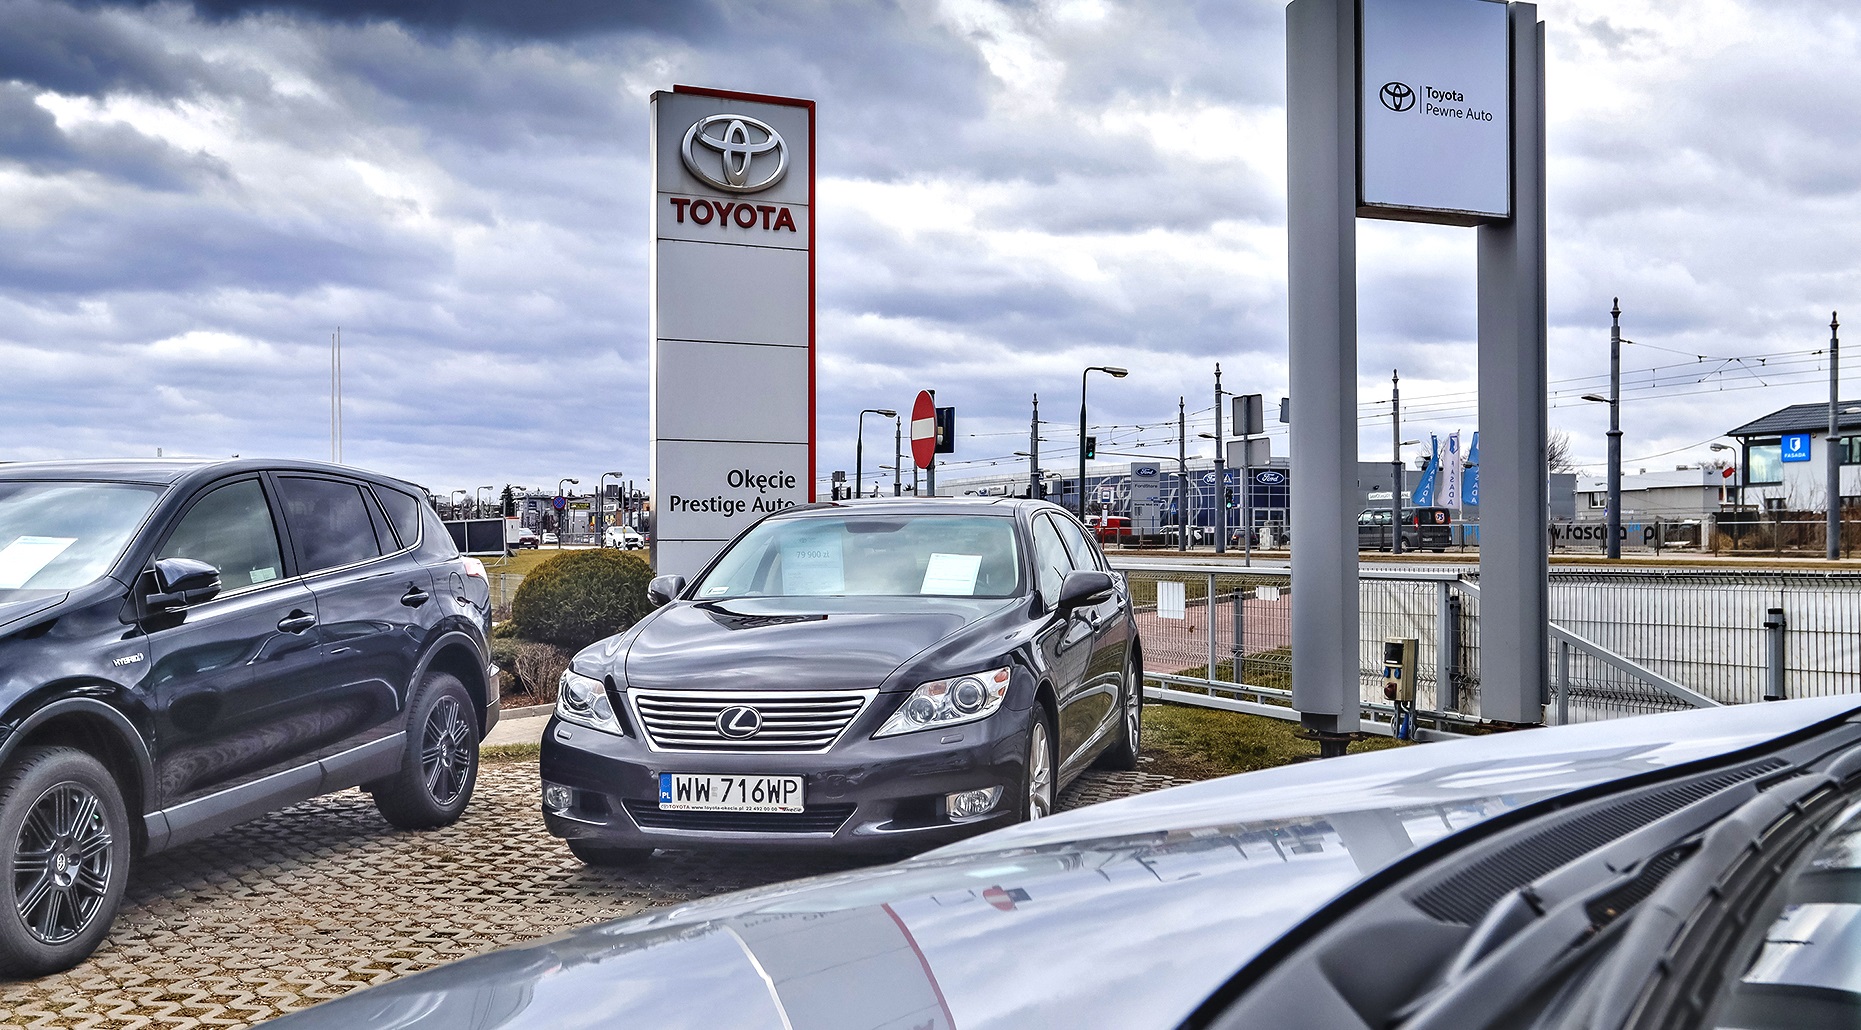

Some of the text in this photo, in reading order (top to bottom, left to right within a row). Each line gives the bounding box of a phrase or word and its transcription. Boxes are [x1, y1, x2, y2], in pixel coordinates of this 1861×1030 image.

[1425, 86, 1464, 102] Toyota
[1426, 103, 1493, 122] Pewne Auto
[670, 197, 797, 232] TOYOTA
[727, 469, 796, 494] Okęcie
[1261, 473, 1279, 482] Ford
[670, 495, 746, 517] Prestige
[796, 551, 806, 559] 79
[807, 550, 822, 559] 900
[675, 777, 798, 804] WW 716WP
